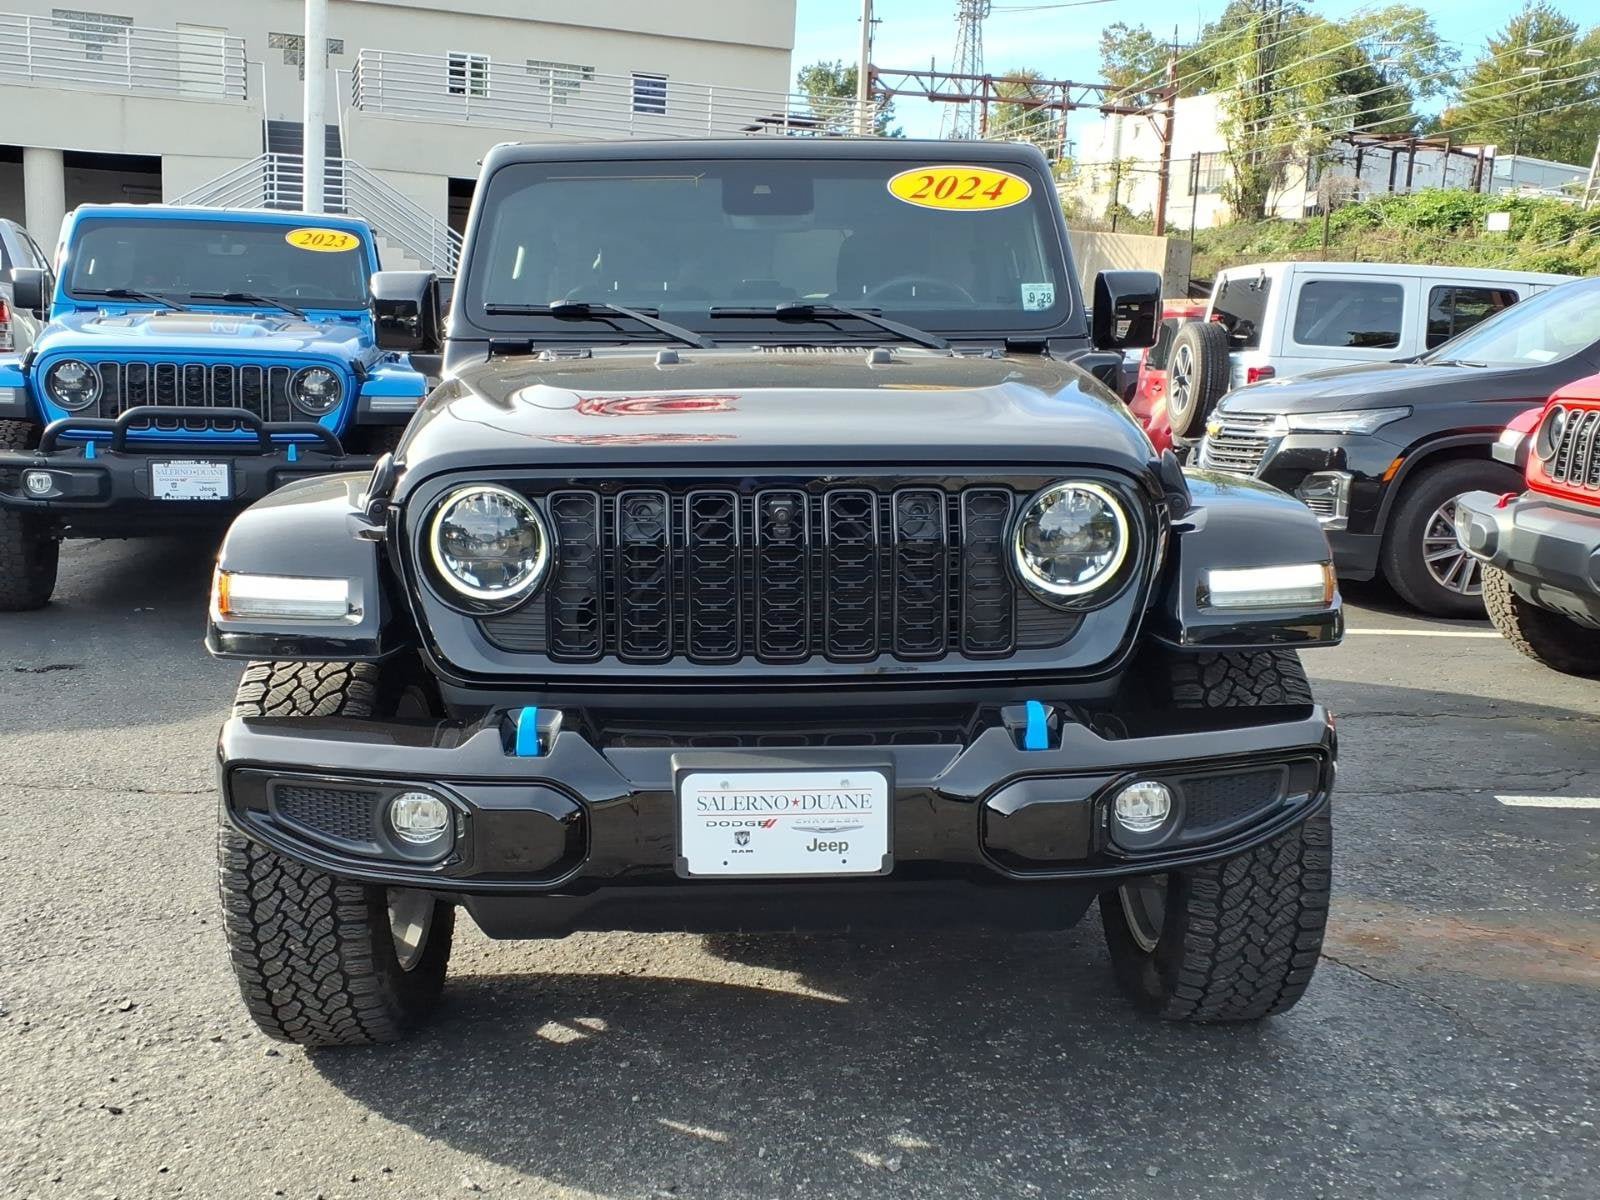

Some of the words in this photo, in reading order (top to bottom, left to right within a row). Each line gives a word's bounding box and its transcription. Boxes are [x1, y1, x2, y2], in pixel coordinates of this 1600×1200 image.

[909, 175, 1009, 200] 2024
[301, 233, 347, 247] 2023
[697, 794, 789, 811] SALERNO
[802, 793, 873, 810] DUANE
[706, 820, 769, 828] DODGE
[806, 838, 849, 854] Jeep
